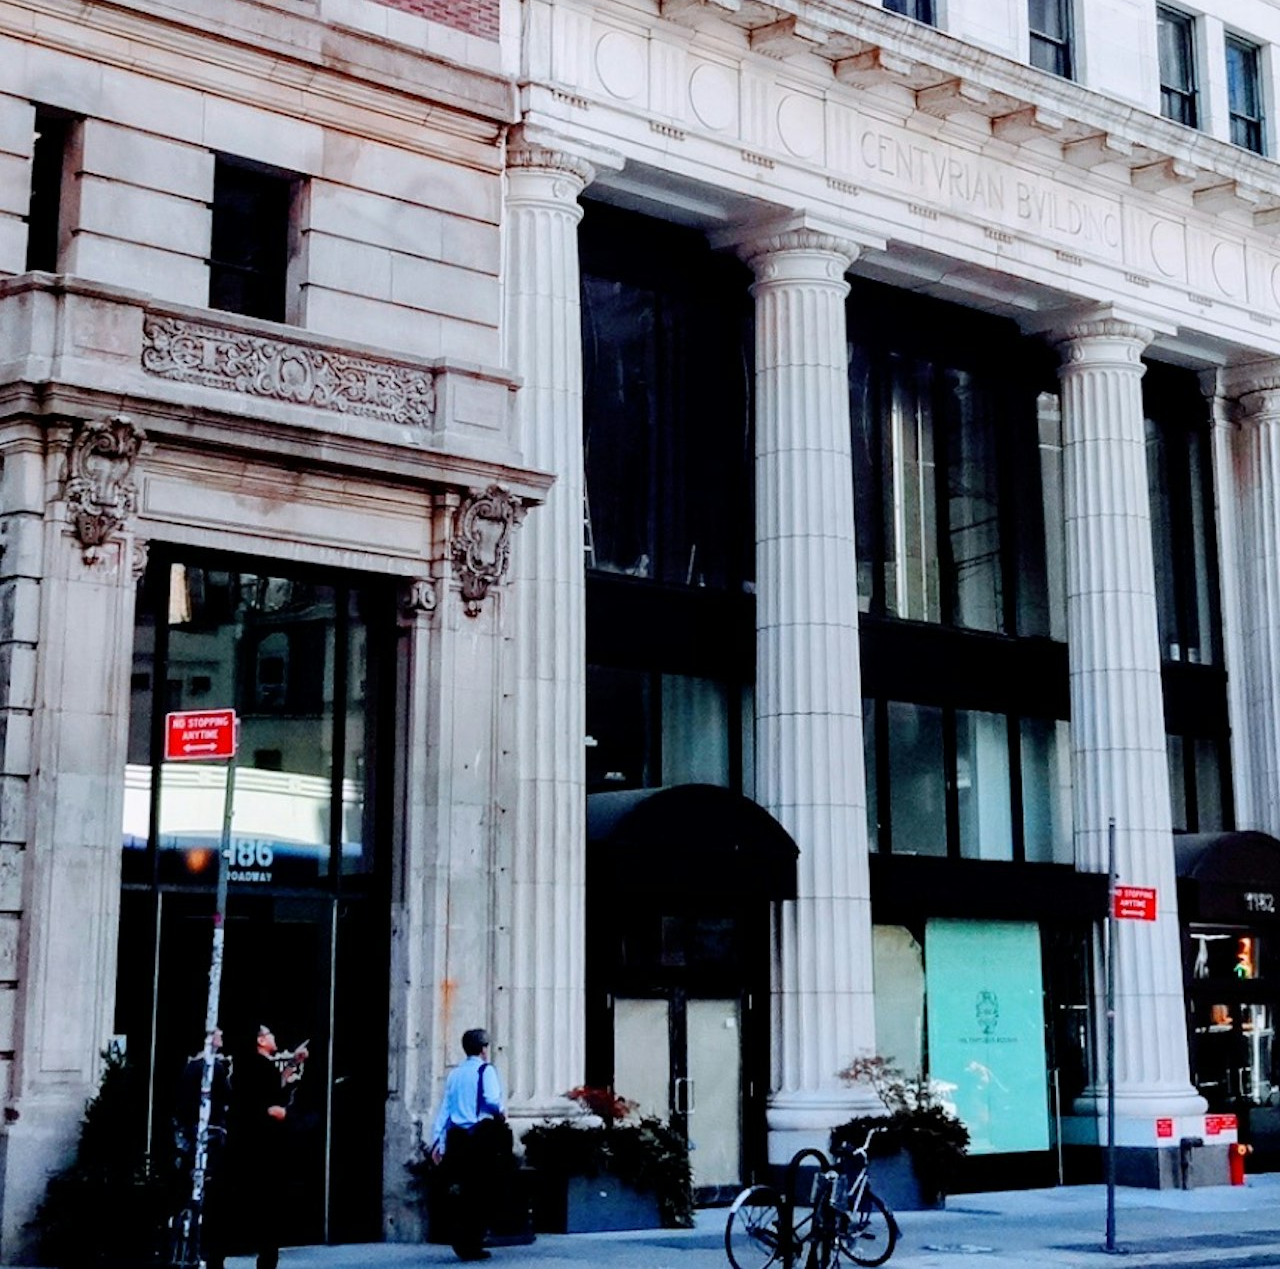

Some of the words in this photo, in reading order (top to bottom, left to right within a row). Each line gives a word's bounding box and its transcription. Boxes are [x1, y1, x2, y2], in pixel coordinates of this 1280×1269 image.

[173, 718, 186, 729] NO
[188, 716, 229, 728] STOPPING
[182, 729, 219, 741] ANYTIME
